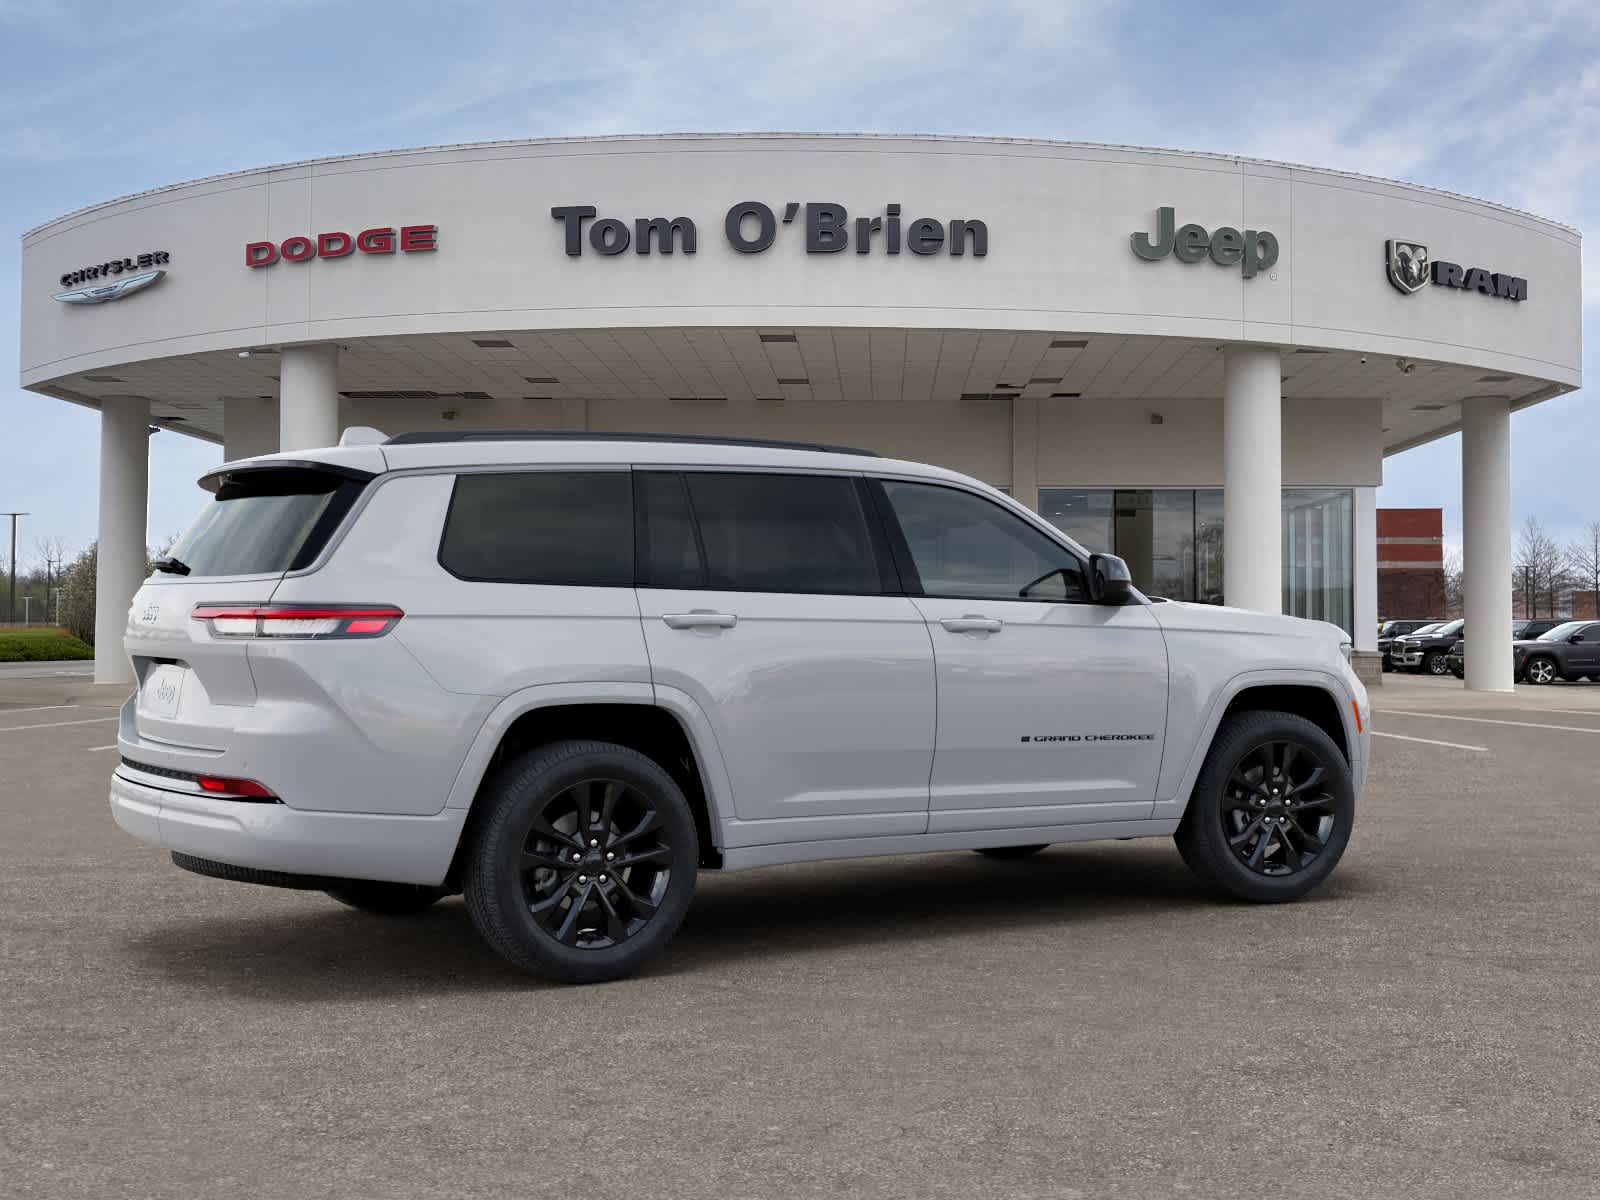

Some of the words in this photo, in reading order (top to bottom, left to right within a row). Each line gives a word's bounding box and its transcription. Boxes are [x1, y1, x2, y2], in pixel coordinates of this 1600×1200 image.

[245, 225, 437, 269] DODGE
[551, 204, 697, 257] Tom
[725, 201, 988, 257] O'Brien
[1130, 206, 1280, 278] Jeep
[60, 250, 170, 287] CHRYSLER
[1430, 261, 1528, 301] RAM
[1033, 735, 1081, 743] GRAND
[1084, 734, 1155, 742] CHEROKEE
